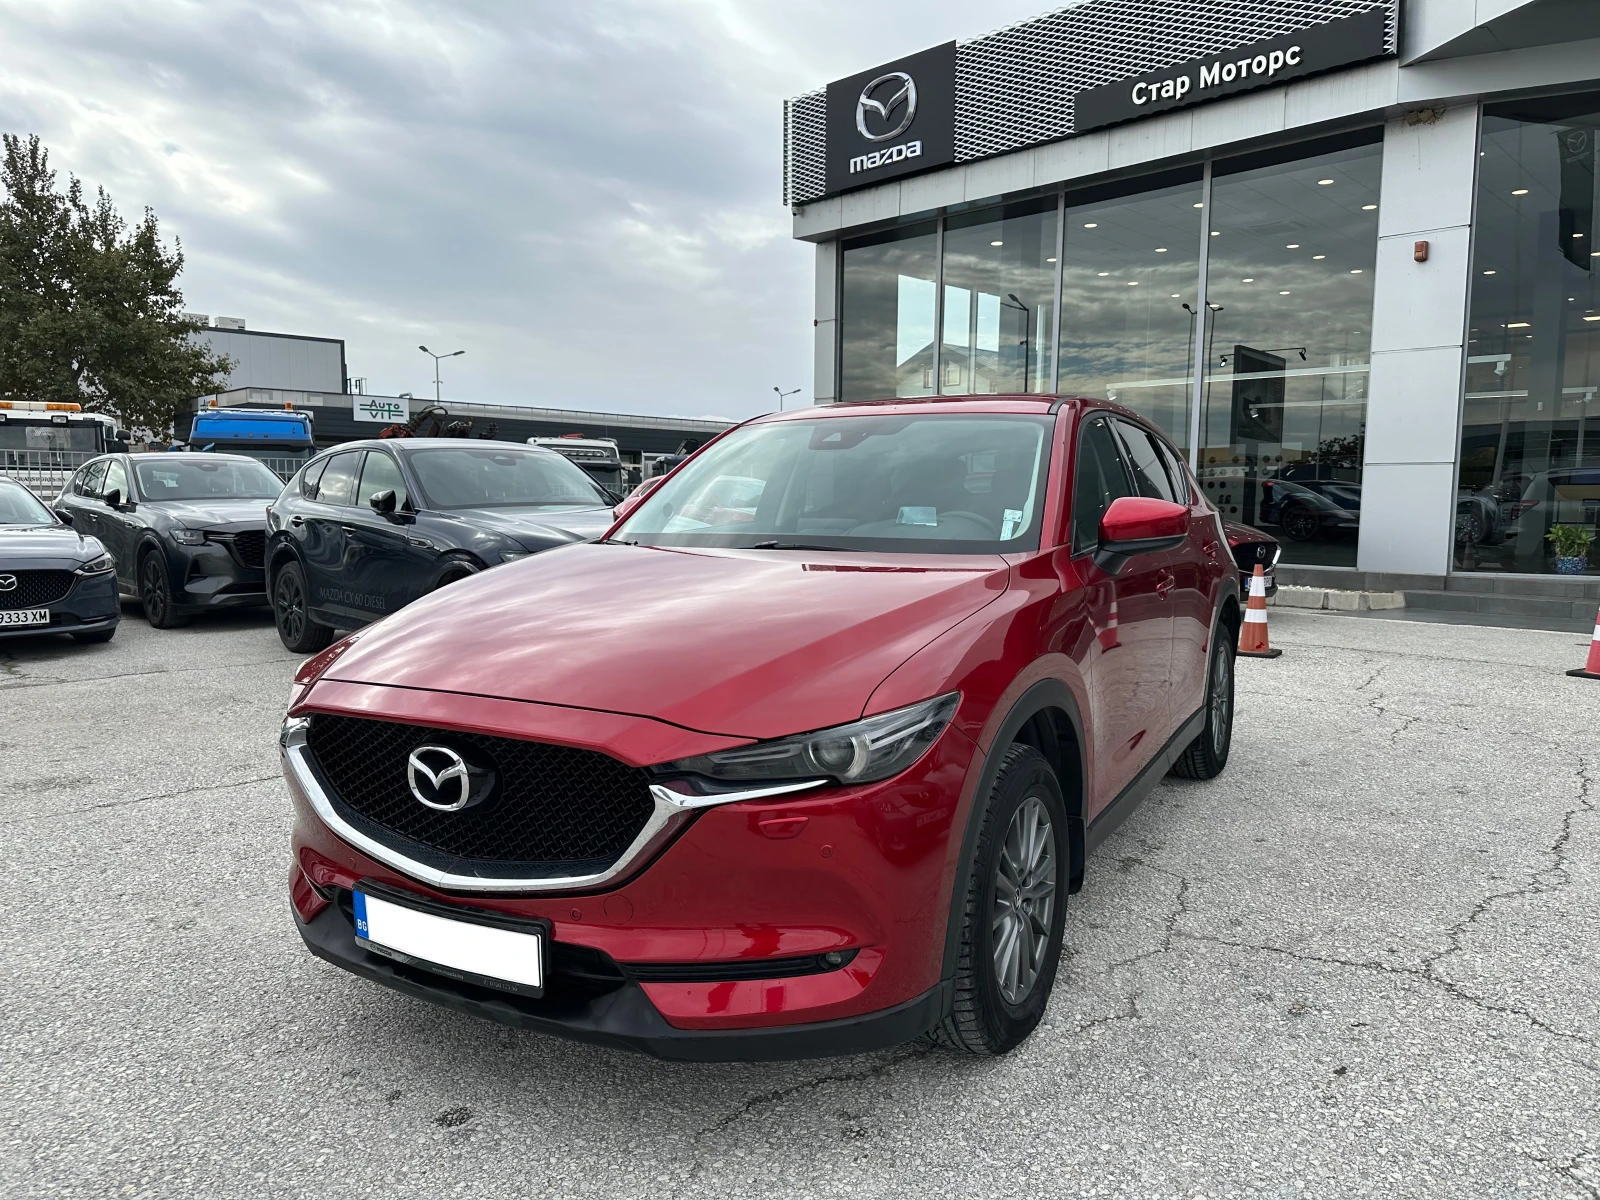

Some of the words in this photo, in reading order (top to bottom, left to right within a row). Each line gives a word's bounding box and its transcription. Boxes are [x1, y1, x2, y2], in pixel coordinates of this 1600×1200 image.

[1132, 75, 1190, 105] Стар
[1200, 46, 1301, 89] Моторс
[850, 140, 923, 174] mazda
[320, 587, 343, 602] MAZDA
[344, 591, 354, 604] CX
[355, 594, 363, 606] 60
[365, 594, 386, 609] DIESEL
[31, 611, 47, 622] XM
[357, 919, 367, 931] BG
